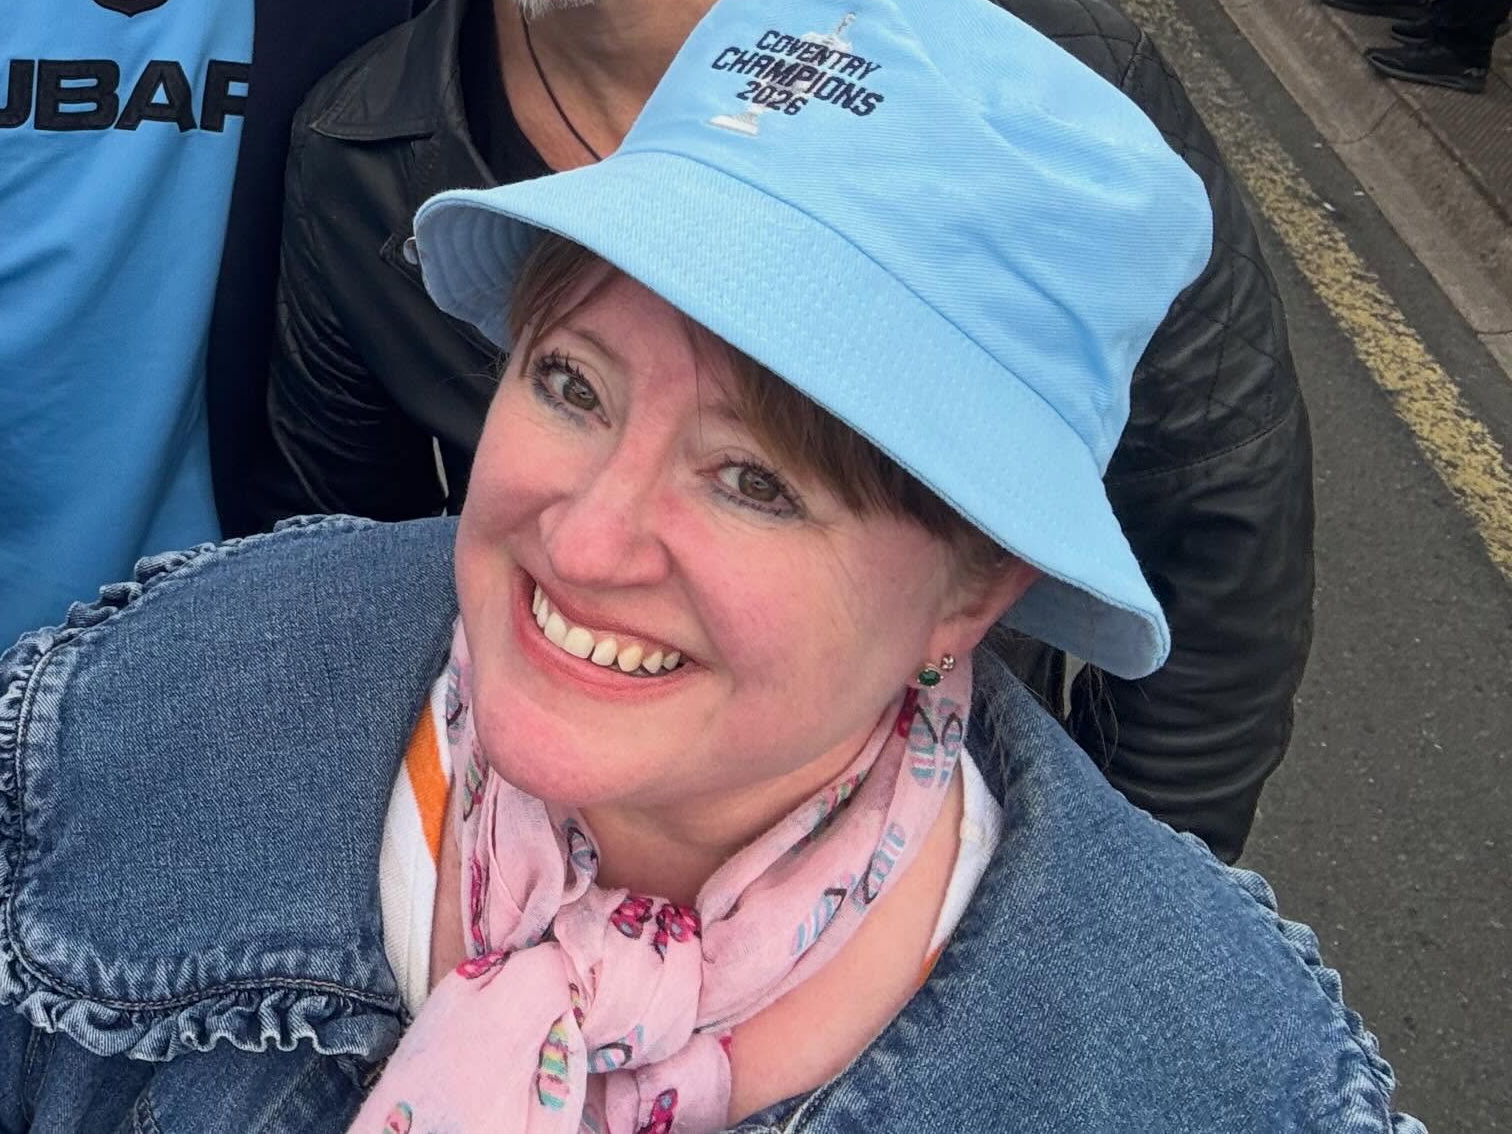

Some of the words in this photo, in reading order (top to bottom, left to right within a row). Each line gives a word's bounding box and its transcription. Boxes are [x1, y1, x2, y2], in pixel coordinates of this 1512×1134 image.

[755, 29, 882, 80] COVENTRY
[711, 46, 885, 116] CHAMPIONS
[736, 81, 809, 115] 2026
